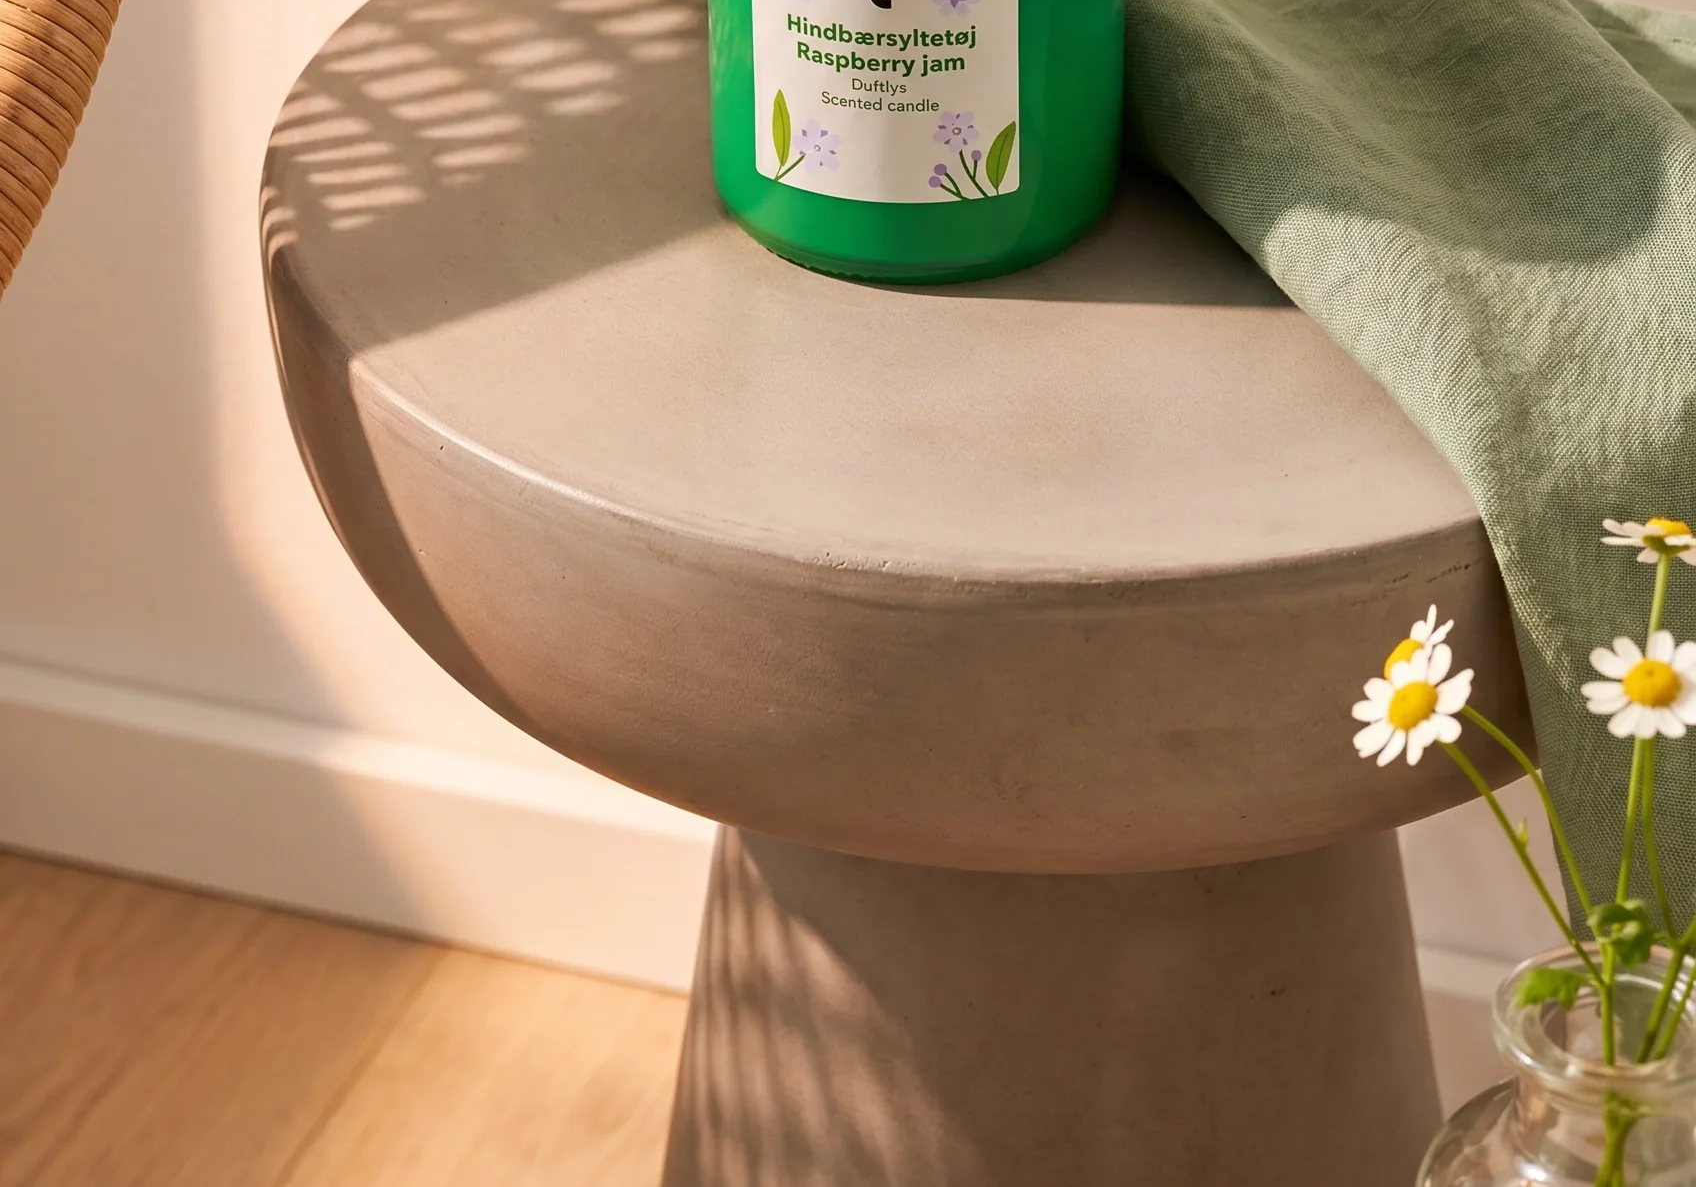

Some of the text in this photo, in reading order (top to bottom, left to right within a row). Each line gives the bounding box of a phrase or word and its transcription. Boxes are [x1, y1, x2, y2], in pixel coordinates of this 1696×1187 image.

[787, 14, 977, 51] Hindbærsyltetøj
[797, 41, 965, 77] Raspberry jam
[851, 78, 907, 96] Duftlys
[821, 91, 940, 112] Scented candle
